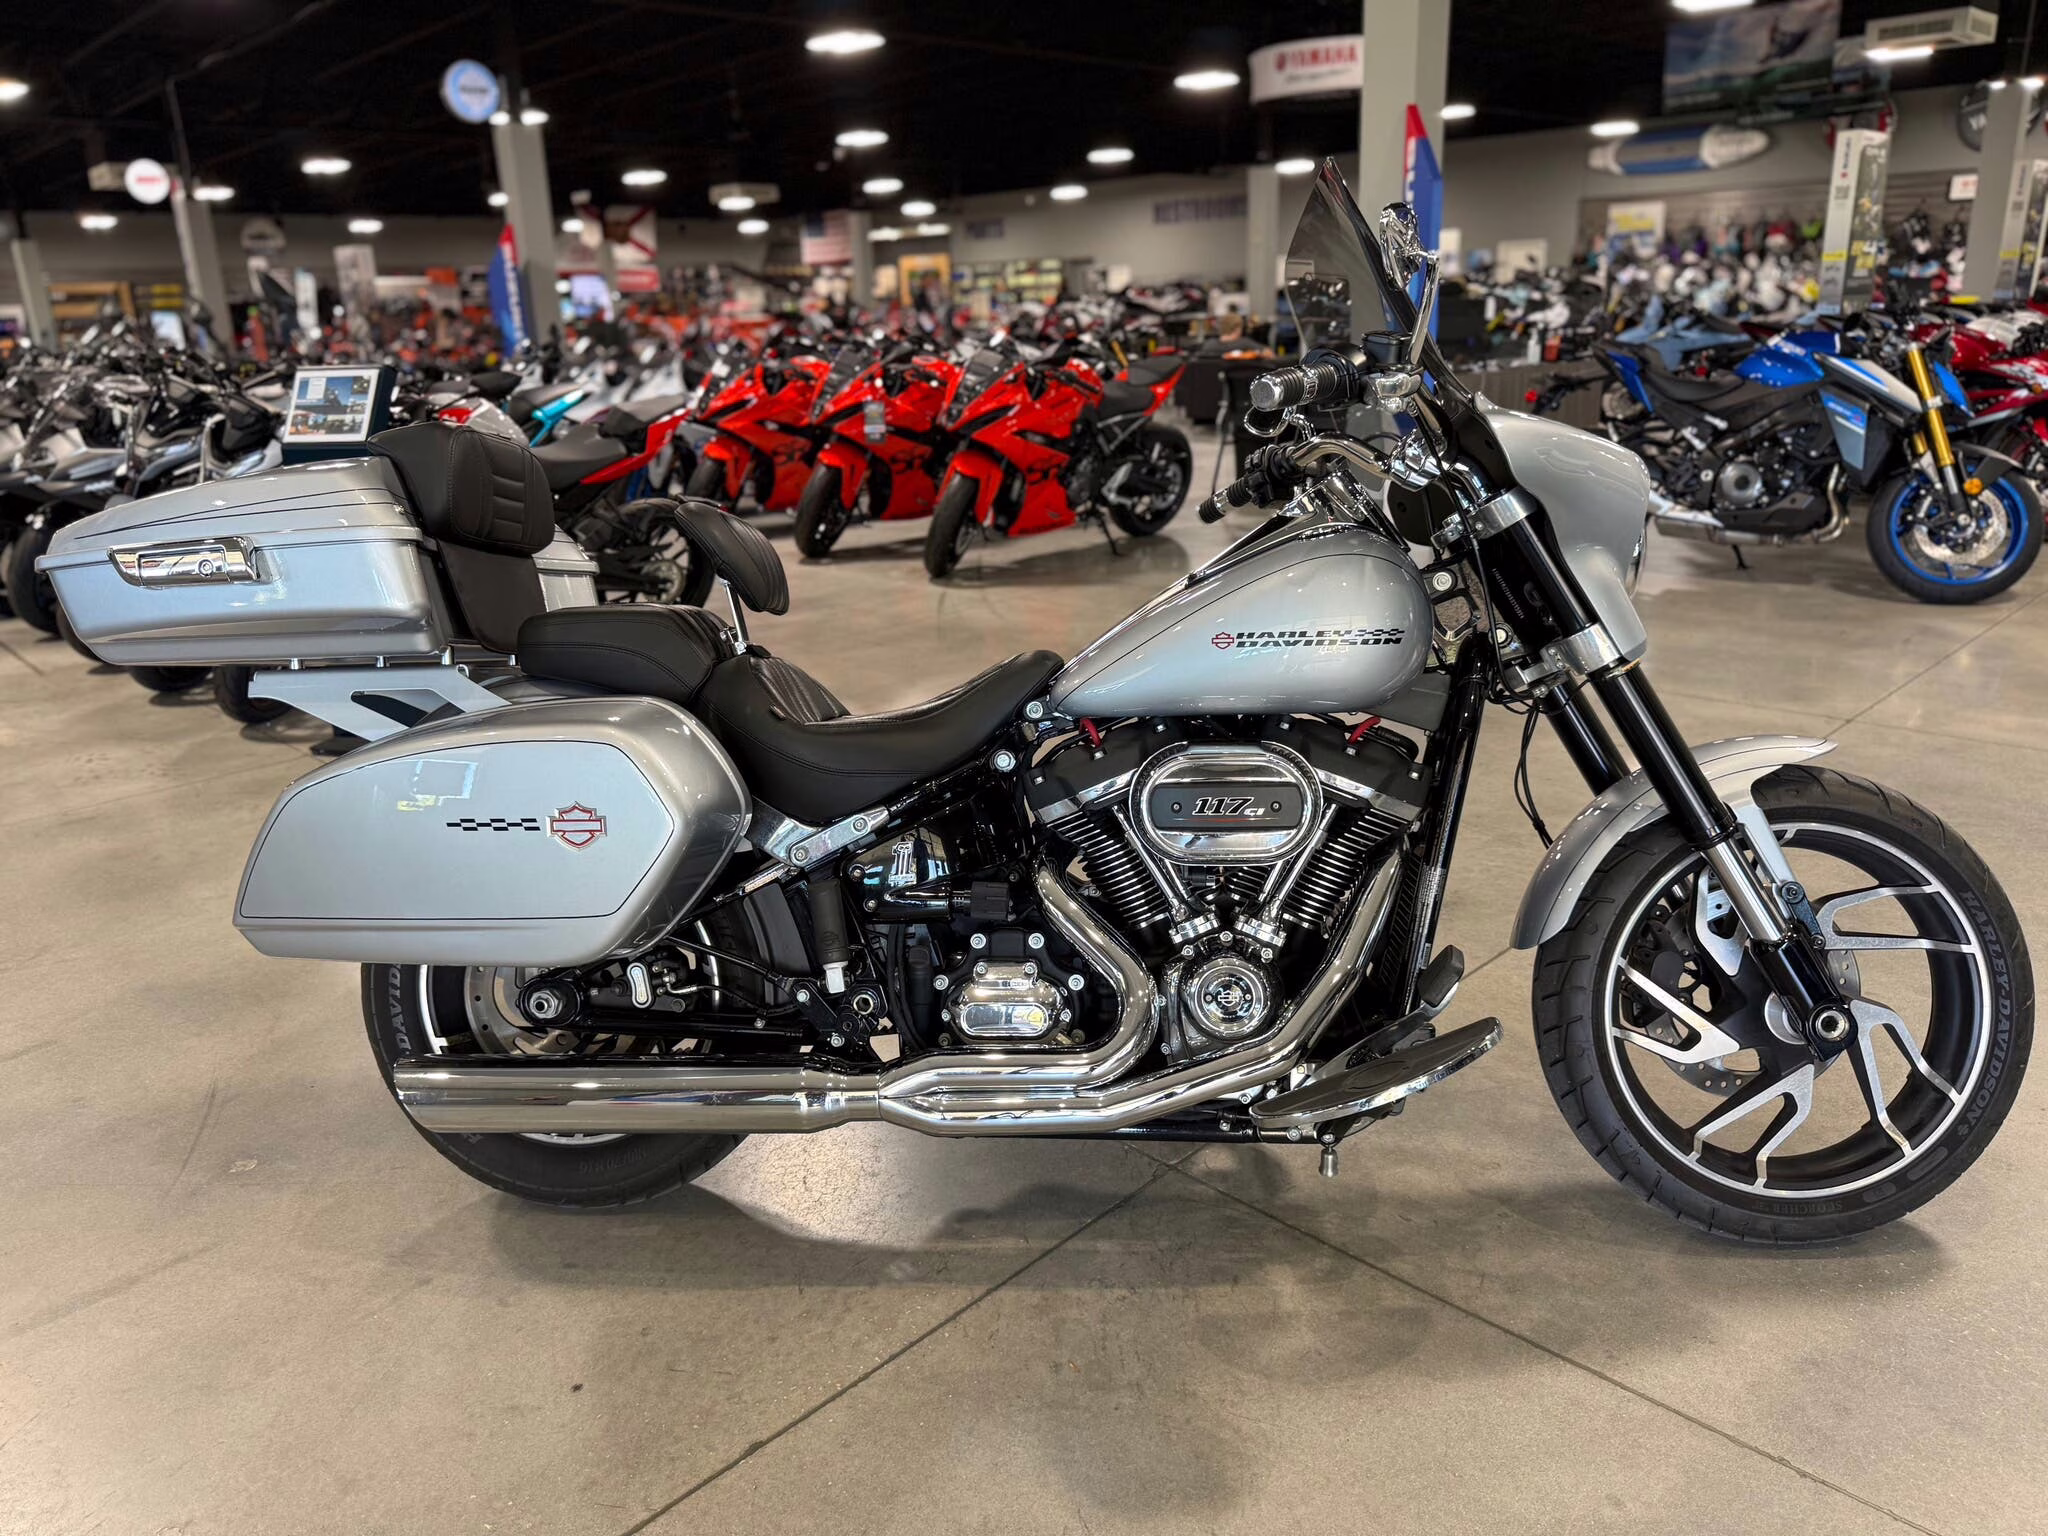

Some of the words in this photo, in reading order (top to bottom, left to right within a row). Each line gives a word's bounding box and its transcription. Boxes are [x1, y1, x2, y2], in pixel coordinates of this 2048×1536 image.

[1235, 630, 1352, 639] HARLEY
[1235, 638, 1403, 648] DAVIDSON
[1191, 796, 1255, 816] 117
